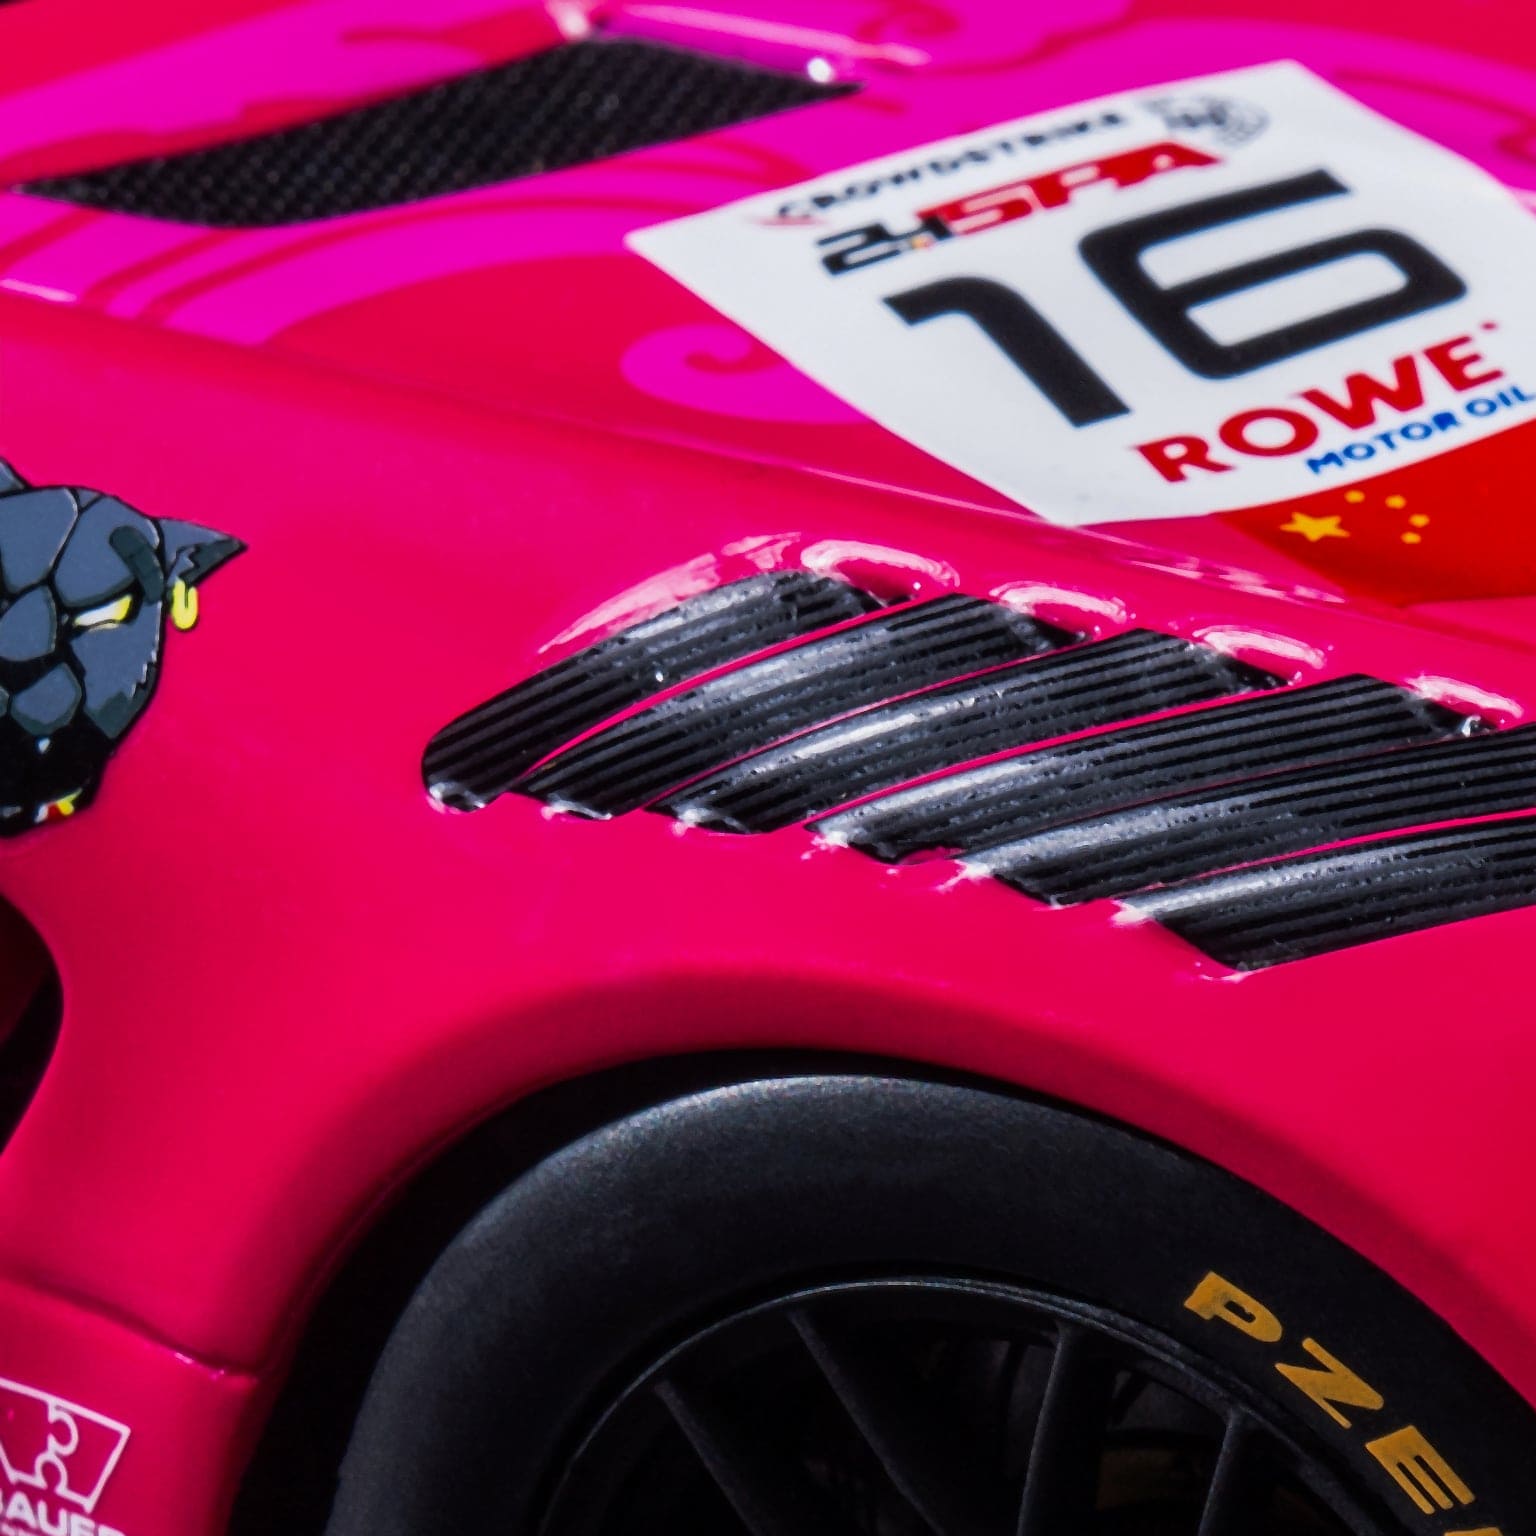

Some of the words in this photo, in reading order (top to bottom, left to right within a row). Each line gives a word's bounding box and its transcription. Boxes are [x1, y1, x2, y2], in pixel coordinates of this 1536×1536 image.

[883, 168, 1468, 428] 16
[1135, 335, 1505, 484] ROWE
[1306, 411, 1461, 475] MOTOR
